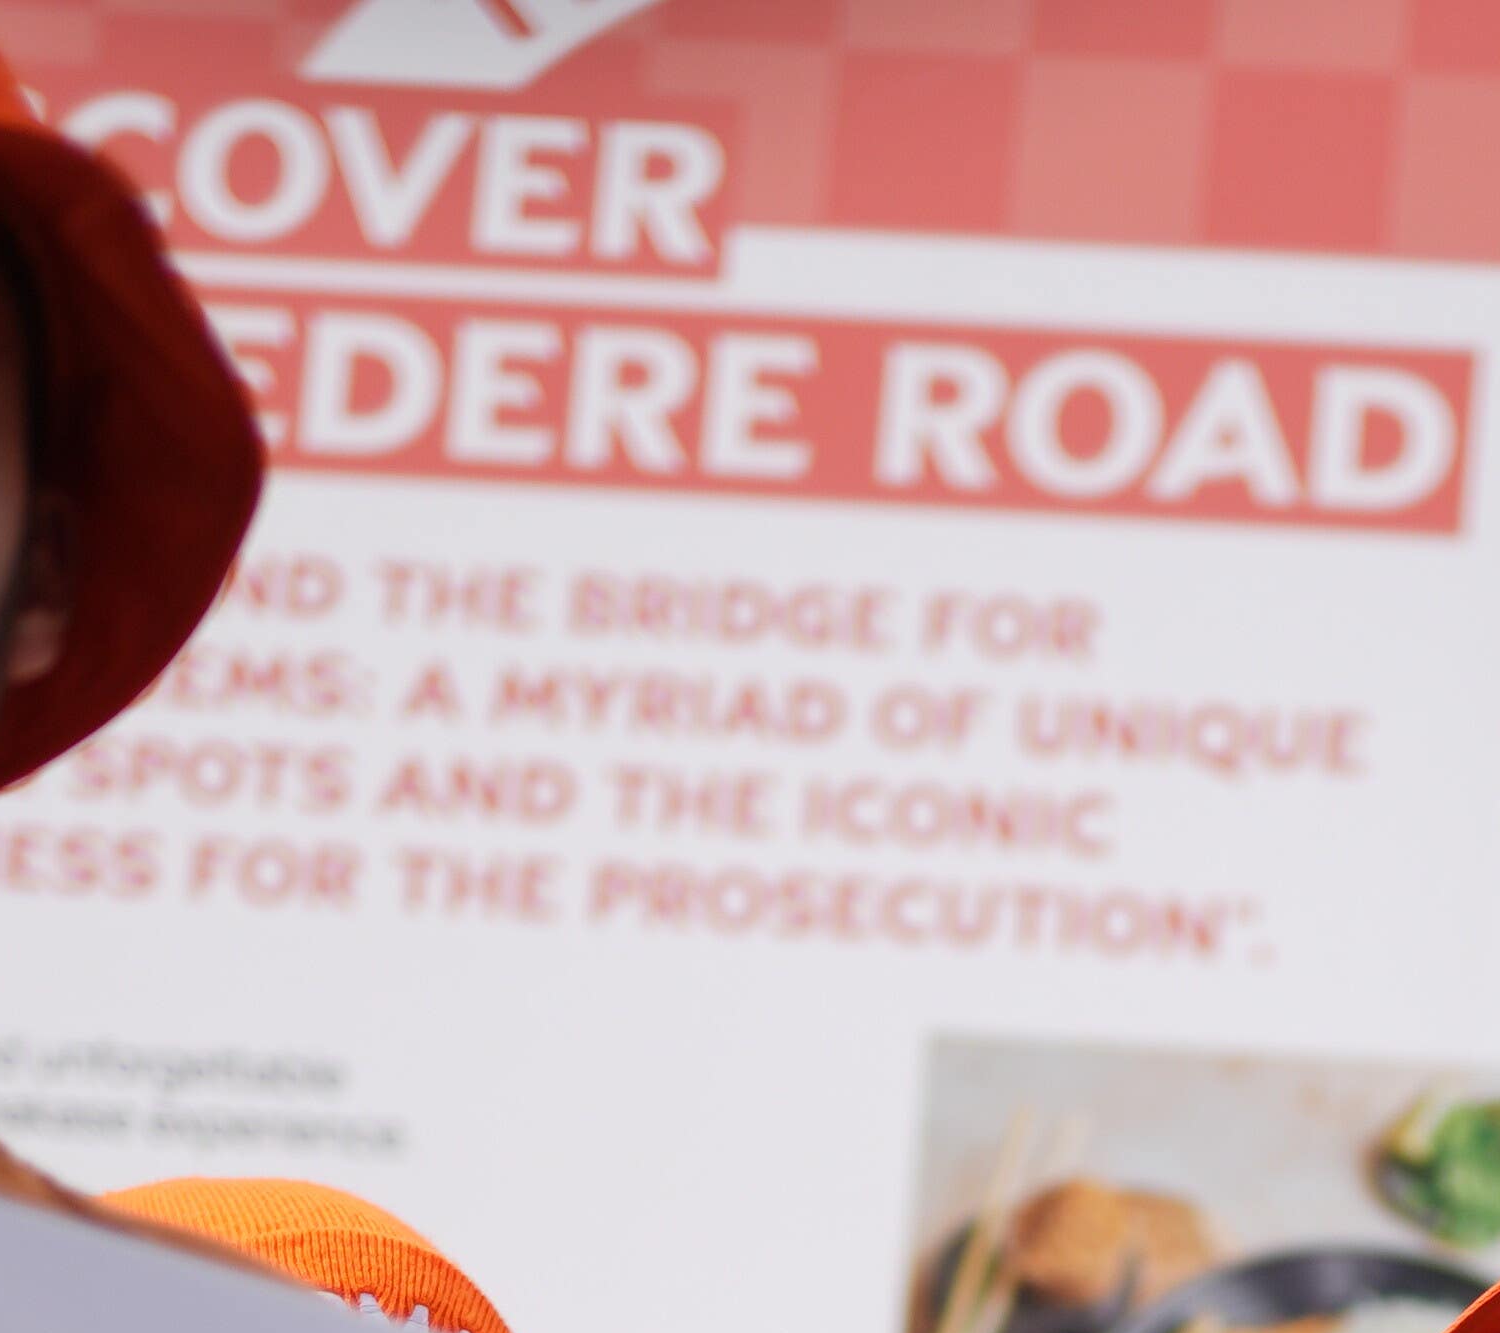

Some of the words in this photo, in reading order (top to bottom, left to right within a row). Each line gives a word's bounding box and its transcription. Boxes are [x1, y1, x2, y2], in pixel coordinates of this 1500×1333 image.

[57, 88, 725, 263] COVER
[875, 331, 1462, 514] ROAD
[374, 560, 543, 635] THE
[564, 570, 898, 655] BRIDGE
[923, 591, 1102, 663] FOR
[402, 660, 456, 719] A
[488, 667, 846, 746] MYRIAD
[870, 683, 990, 752] OF
[1014, 691, 1369, 781] UNIQUE
[374, 755, 576, 829] AND
[610, 762, 776, 839] THE
[800, 776, 1116, 859] ICONIC
[186, 834, 360, 911] FOR
[398, 845, 566, 924] THE
